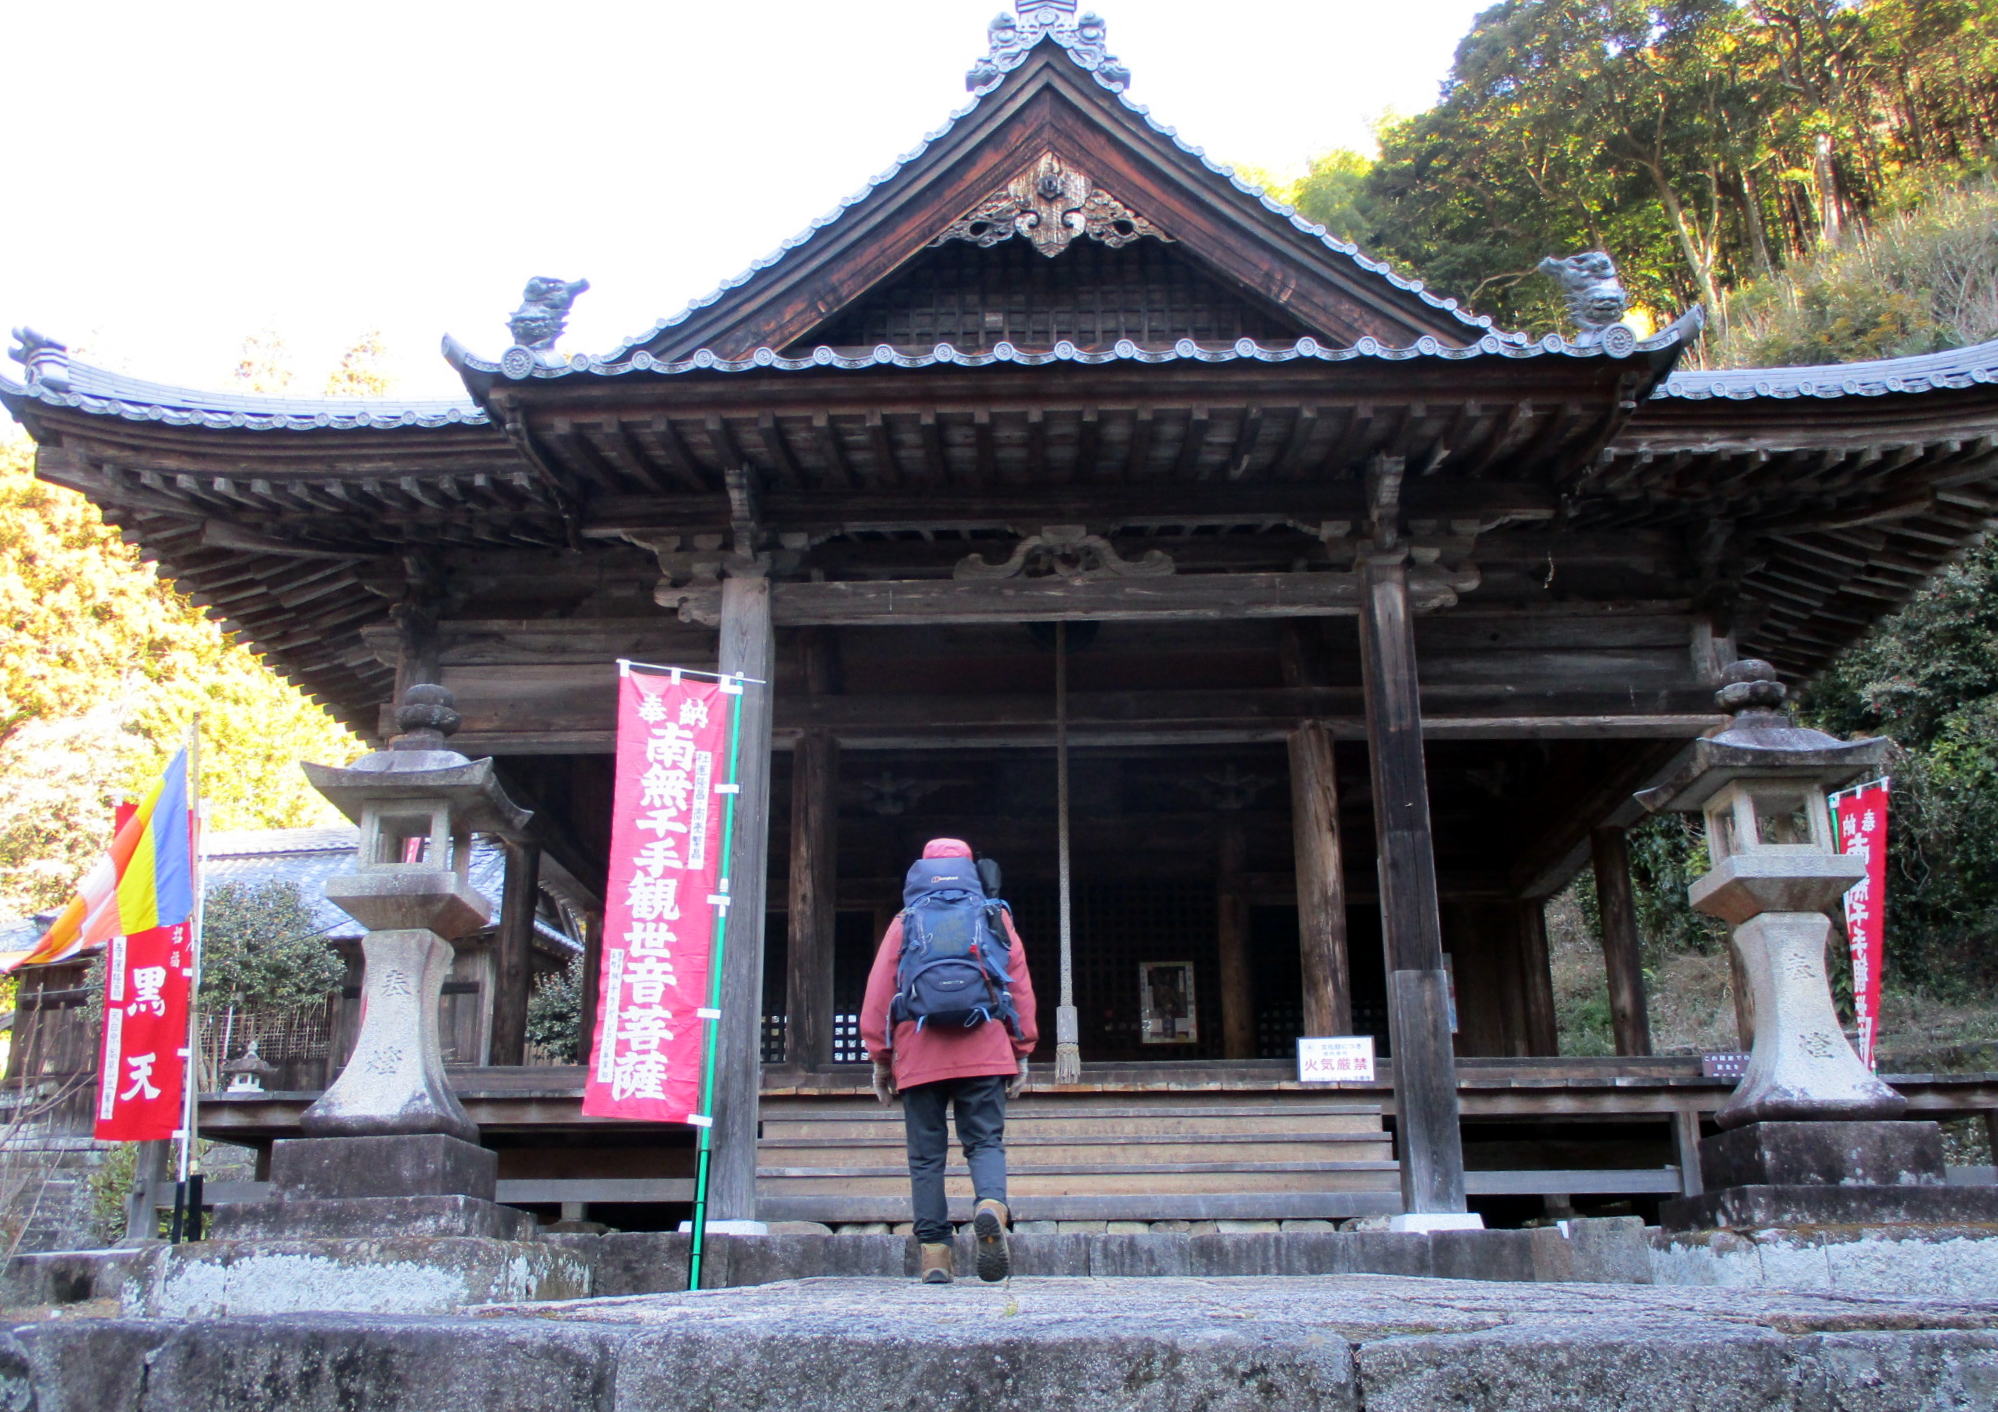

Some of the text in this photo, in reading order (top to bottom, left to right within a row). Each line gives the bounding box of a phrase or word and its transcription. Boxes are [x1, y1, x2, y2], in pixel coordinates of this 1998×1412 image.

[638, 692, 709, 729] 奉納
[614, 722, 696, 1102] 南無千手観世音菩薩
[121, 964, 167, 1102] 黒天
[1304, 1058, 1368, 1072] 火気厳禁
